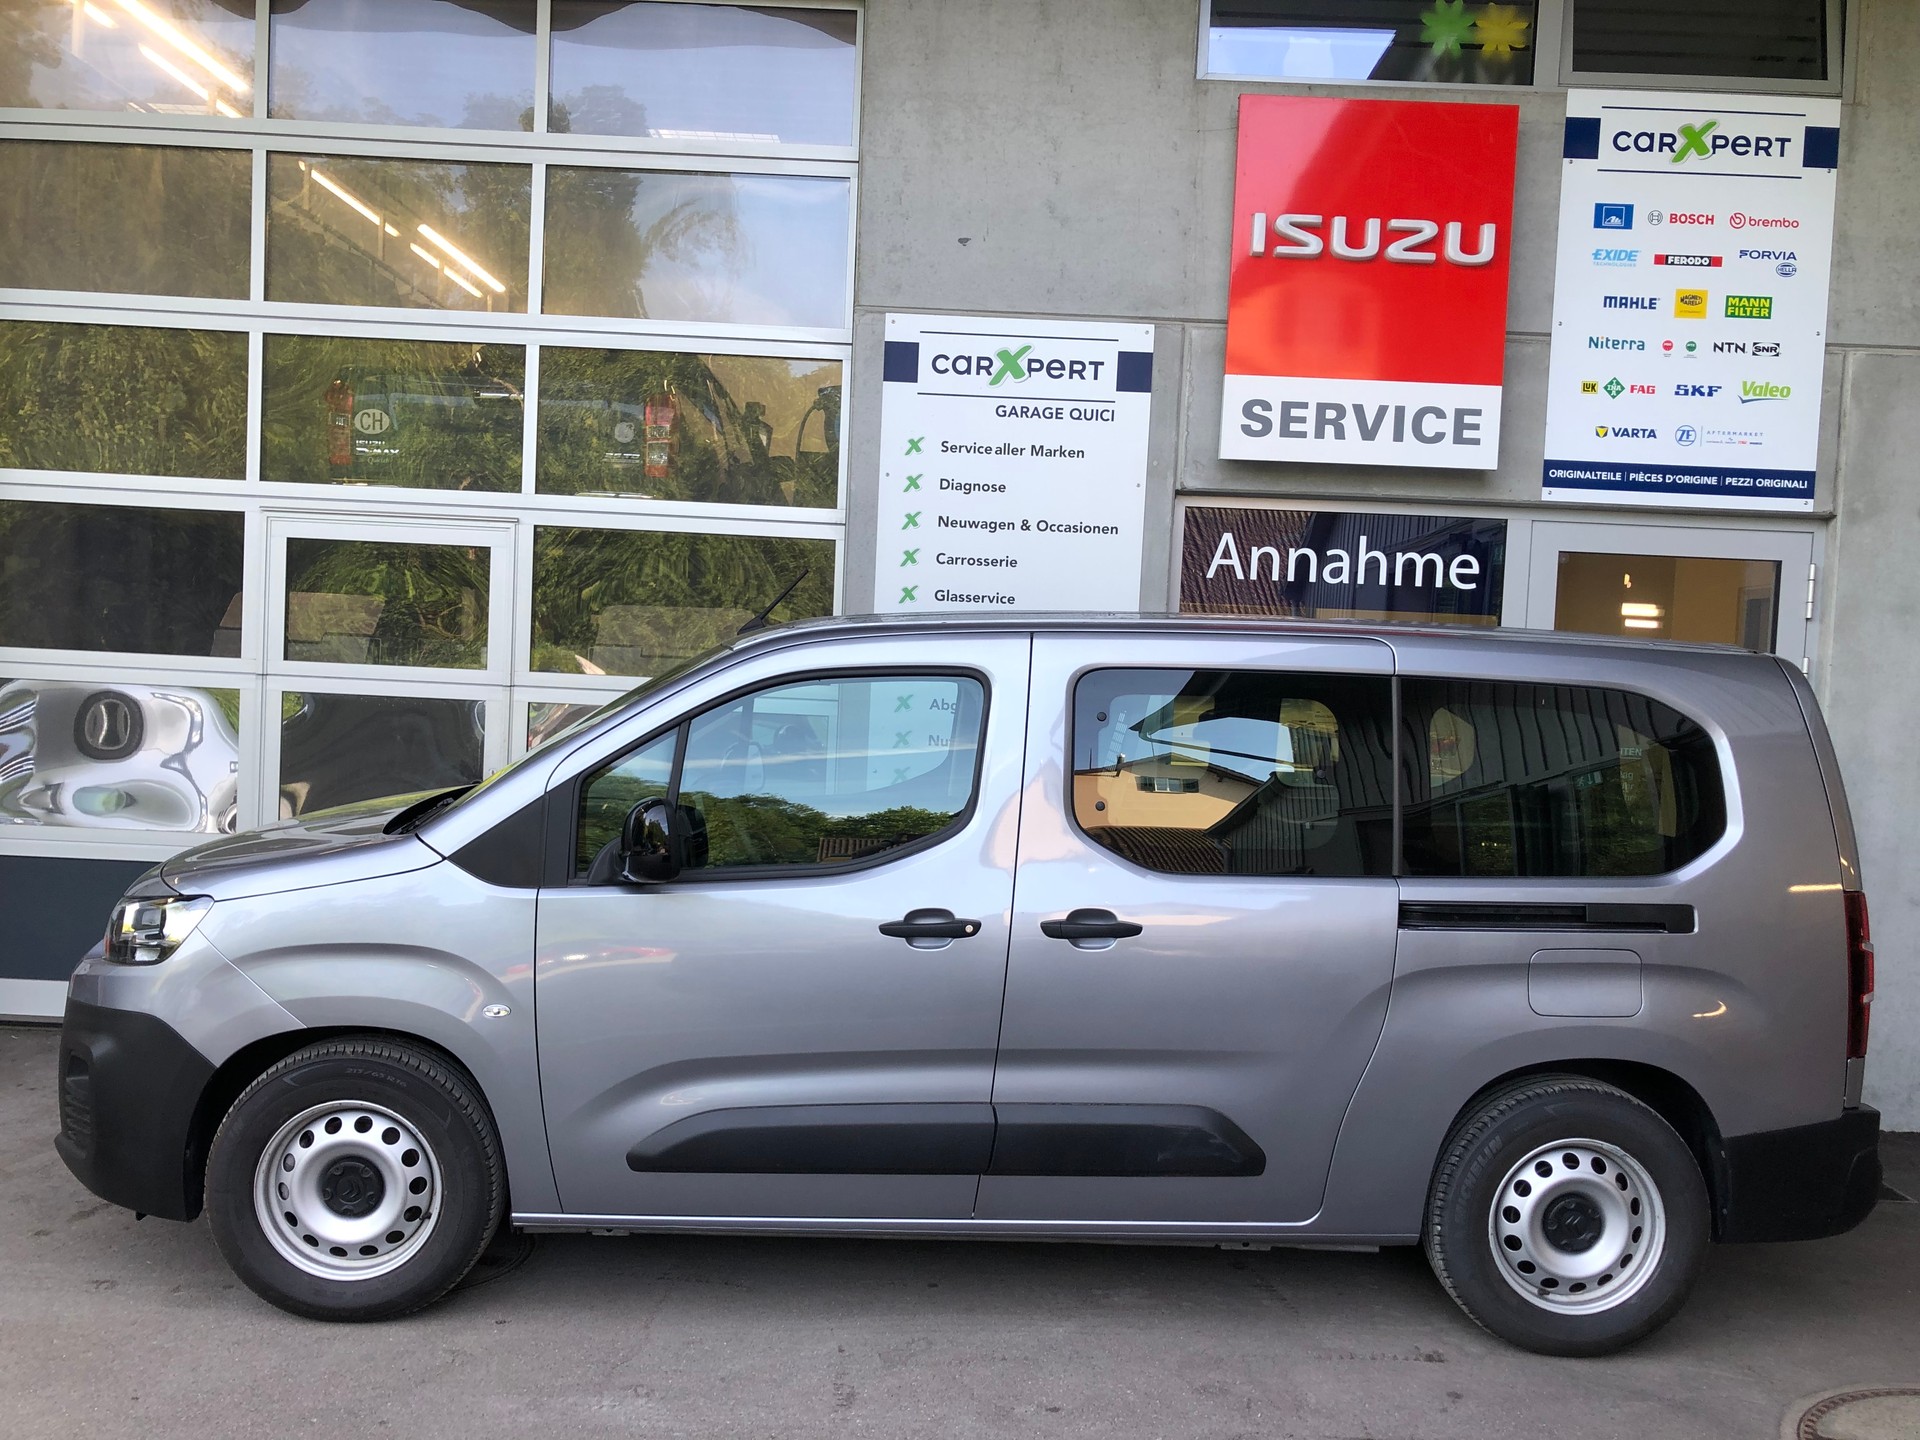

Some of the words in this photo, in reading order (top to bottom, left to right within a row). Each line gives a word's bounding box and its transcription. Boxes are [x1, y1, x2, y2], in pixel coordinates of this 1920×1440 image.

[1669, 213, 1715, 226] BOSCH
[1748, 216, 1799, 229] brembo
[1249, 213, 1496, 266] ISUZU
[1592, 249, 1640, 262] EXIDE
[1667, 256, 1710, 266] FERODO
[1739, 249, 1798, 261] FORVIA
[1602, 295, 1658, 310] MAHLE
[1728, 297, 1770, 307] MANN
[1727, 307, 1769, 317] FILTER
[1588, 336, 1646, 351] Niterra
[1713, 342, 1746, 354] NTN
[1754, 345, 1778, 353] SNR
[1630, 384, 1656, 395] FAG
[1674, 384, 1723, 397] SKF
[1742, 380, 1791, 398] Valeo
[360, 411, 383, 431] CH
[995, 405, 1064, 420] GARAGE
[1069, 408, 1115, 422] QUICI
[1240, 399, 1483, 446] SERVICE
[1611, 427, 1657, 439] VARTA
[1677, 429, 1695, 442] ZF
[940, 441, 993, 456] Service
[995, 442, 1026, 456] aller
[1030, 445, 1085, 459] Marken
[939, 478, 1007, 494] Diagnose
[1549, 469, 1622, 481] ORIGINALTEILE
[1629, 471, 1663, 483] PIÈCES
[1725, 477, 1753, 487] PEZZI
[1756, 478, 1808, 489] ORIGINALI
[937, 515, 1016, 533] Neuwagen
[1020, 519, 1032, 532] &
[1036, 519, 1119, 535] Occasionen
[935, 552, 1018, 568] Carrosserie
[1206, 532, 1480, 590] Annahme
[934, 589, 1016, 605] Glasservice
